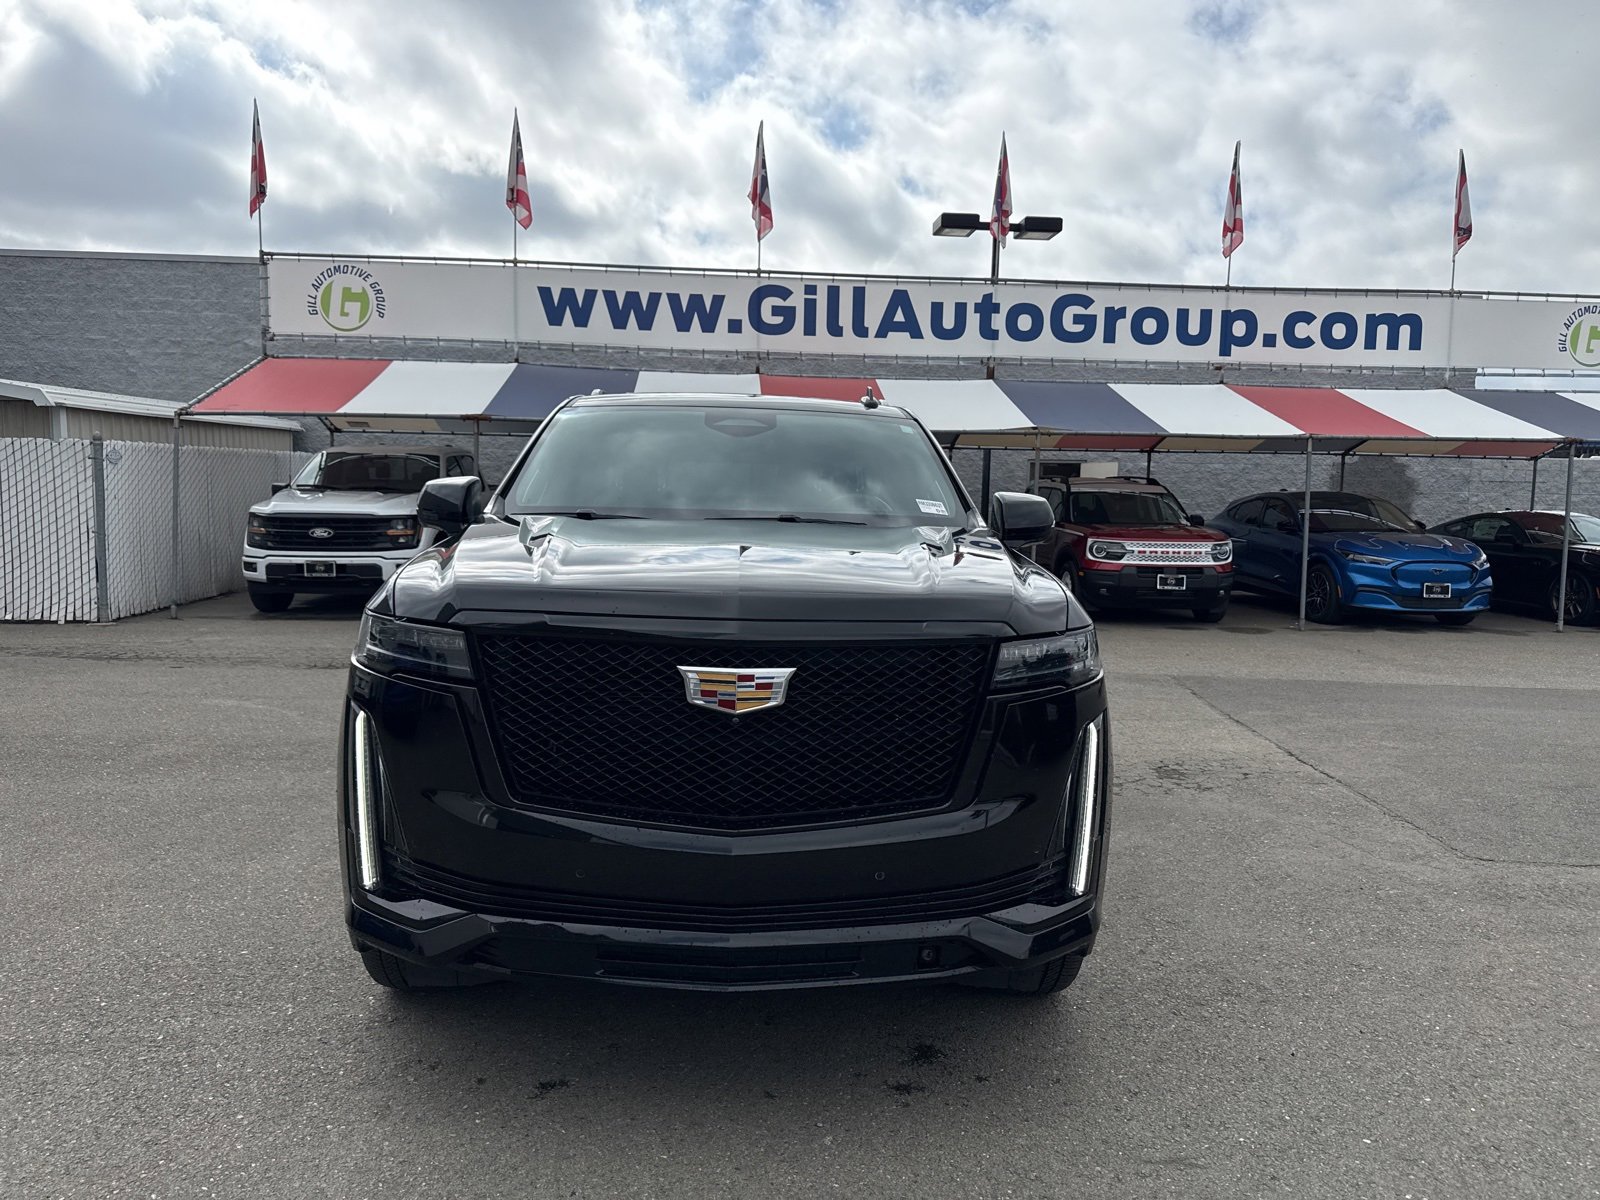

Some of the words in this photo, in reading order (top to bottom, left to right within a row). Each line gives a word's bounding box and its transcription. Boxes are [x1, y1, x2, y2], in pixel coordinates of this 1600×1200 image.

[311, 264, 373, 293] AUTOMOTIVE
[307, 294, 319, 316] GILL
[369, 281, 386, 319] GROUP
[537, 284, 1423, 357] www.GillAutoGroup.com
[1558, 332, 1568, 353] GILL
